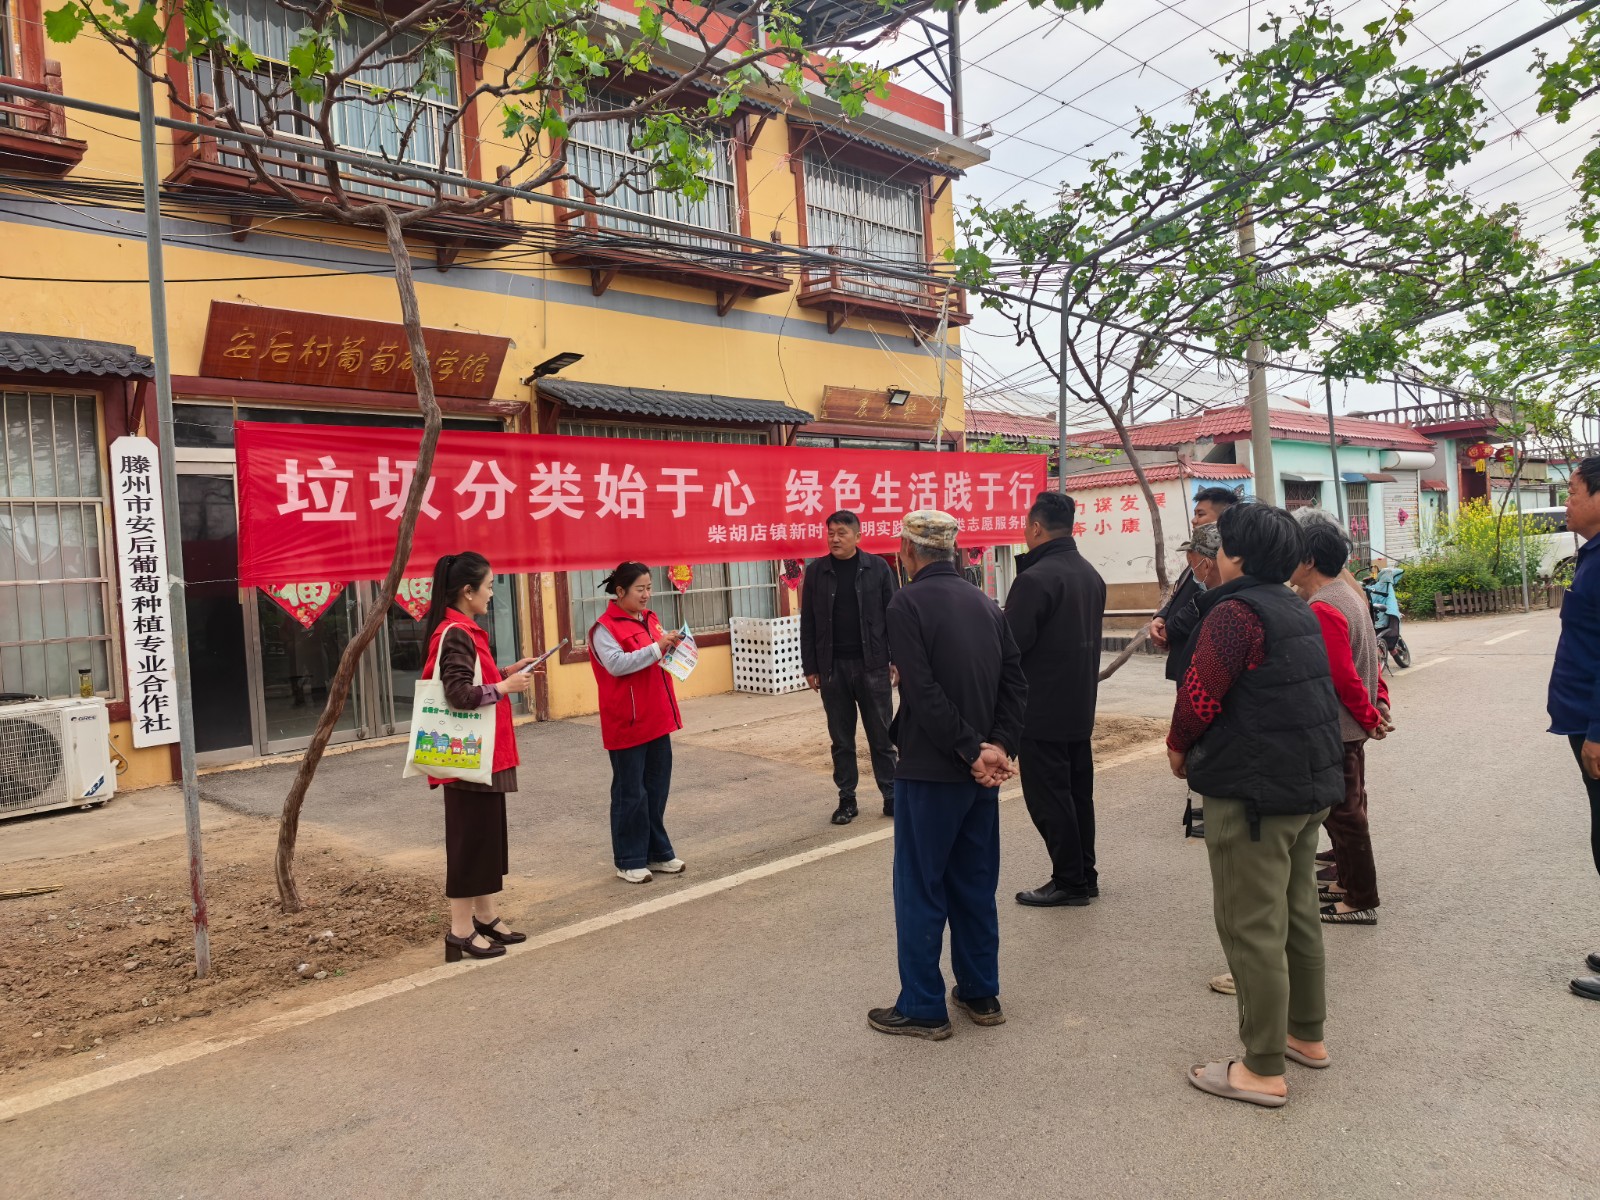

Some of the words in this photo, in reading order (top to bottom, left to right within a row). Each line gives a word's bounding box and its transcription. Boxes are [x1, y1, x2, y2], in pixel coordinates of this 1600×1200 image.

[276, 455, 755, 522] 垃圾分类始于心
[786, 467, 1035, 516] 绿色生活践于行
[120, 455, 172, 734] 滕州市安后葡萄种植专业合作社
